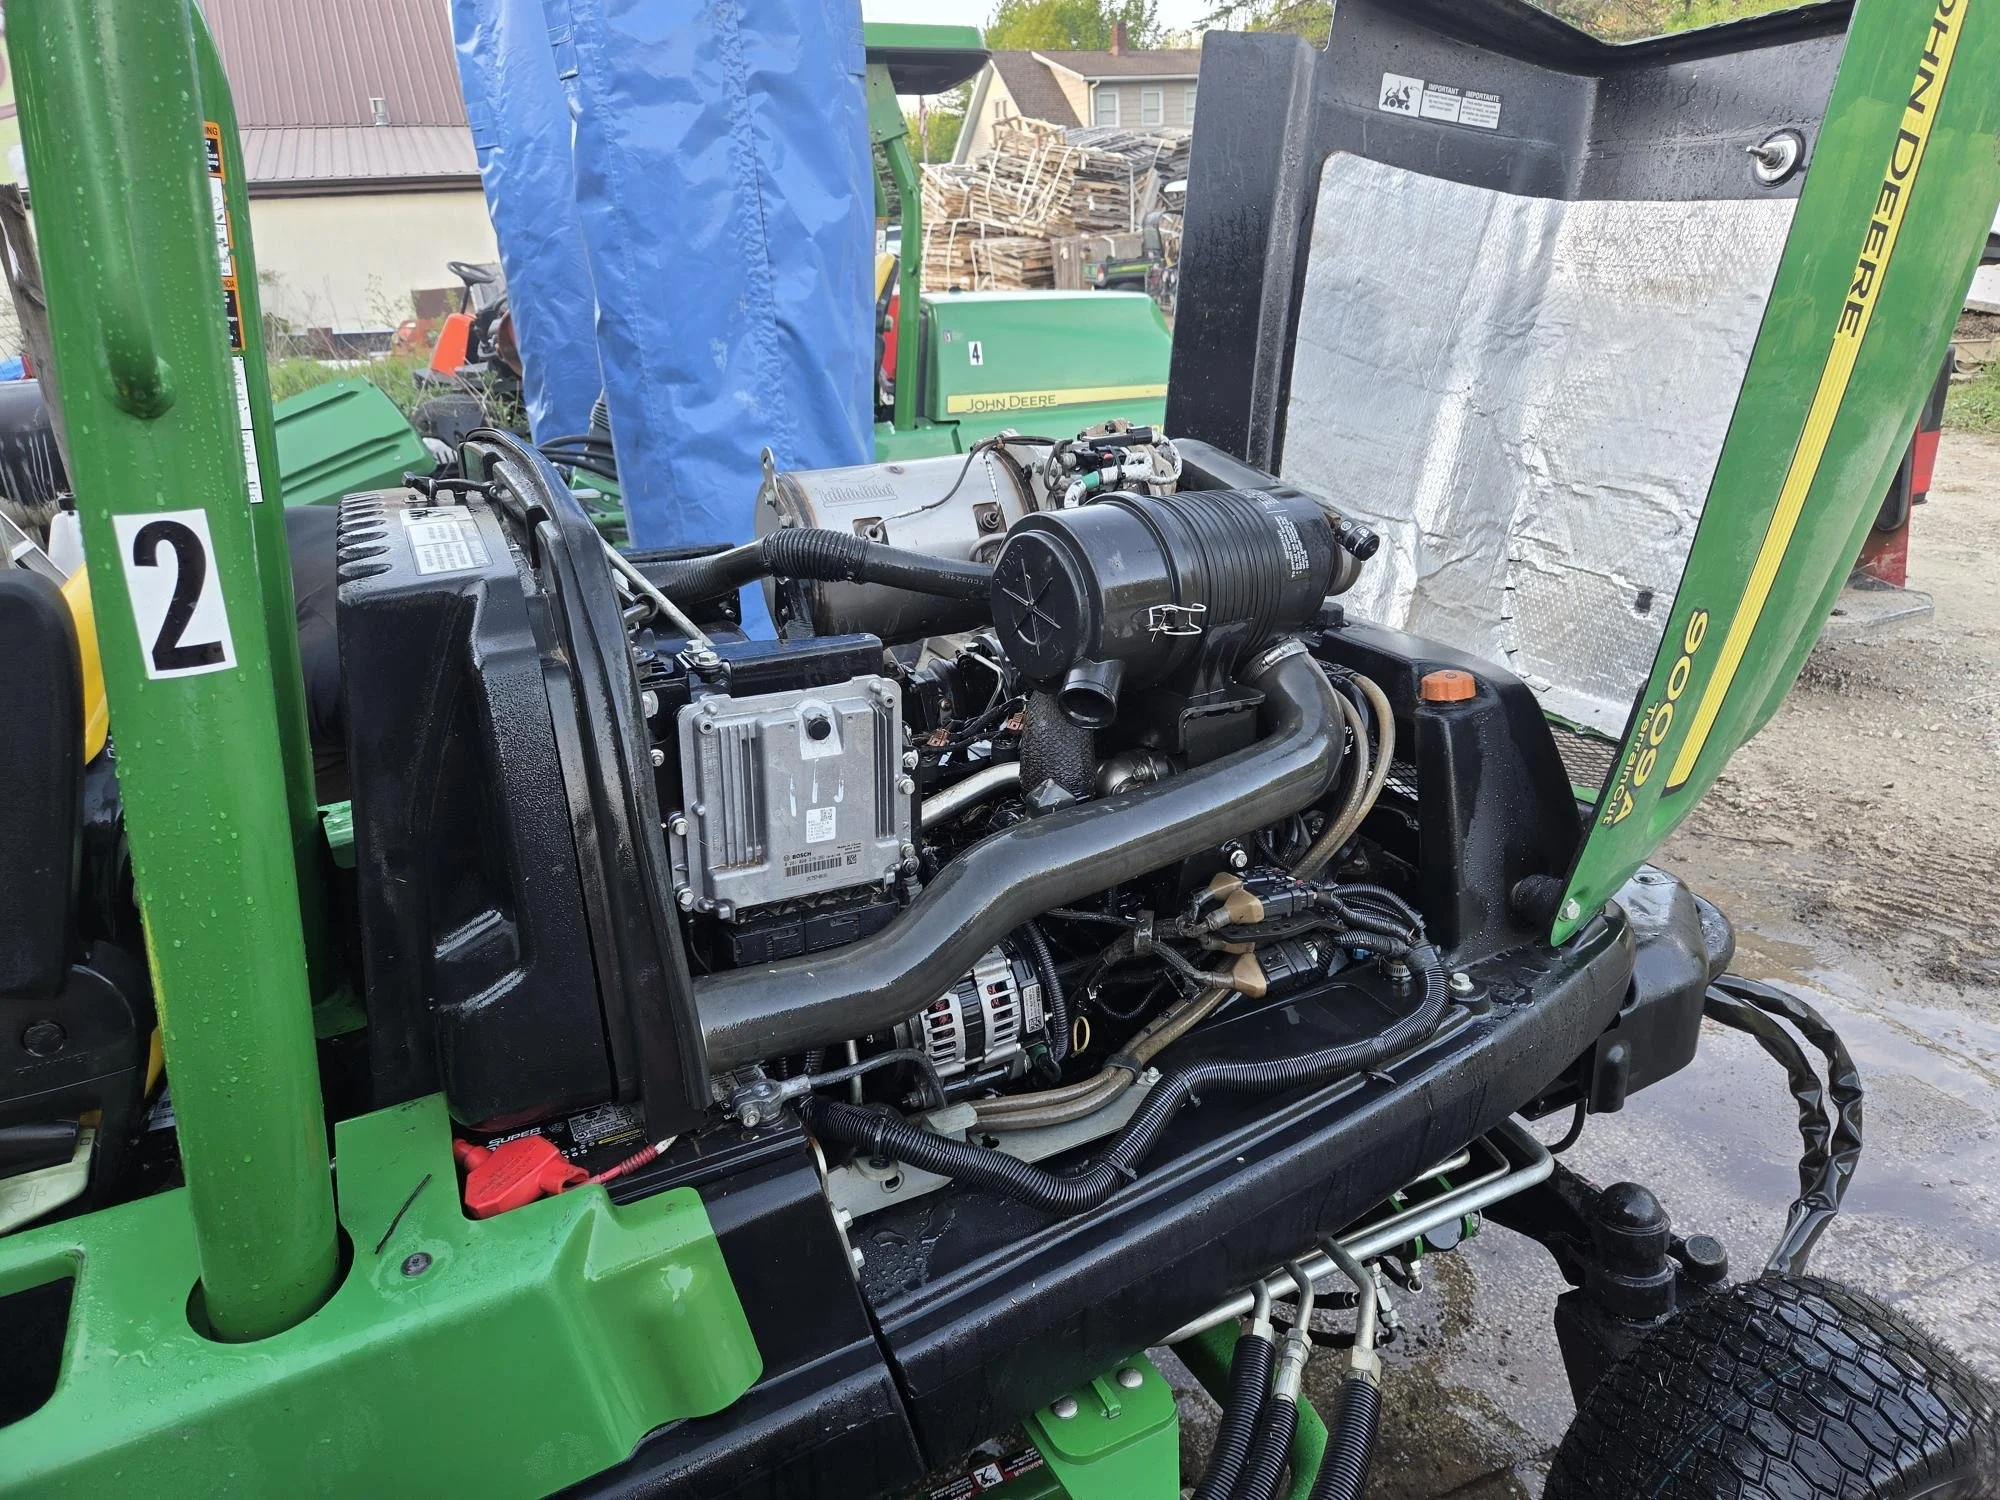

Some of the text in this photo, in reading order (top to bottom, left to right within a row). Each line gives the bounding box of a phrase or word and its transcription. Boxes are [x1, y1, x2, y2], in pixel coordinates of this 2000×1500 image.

[1428, 83, 1459, 95] IMPORTANT
[1465, 91, 1500, 102] IMPORTANTE
[1838, 128, 1920, 338] DEERE
[972, 343, 980, 363] 4
[967, 395, 1056, 410] JOHN DEERE
[132, 520, 226, 671] 2
[1612, 609, 1709, 824] 9009A
[792, 851, 812, 859] BOSCH
[488, 1127, 541, 1144] SUPER
